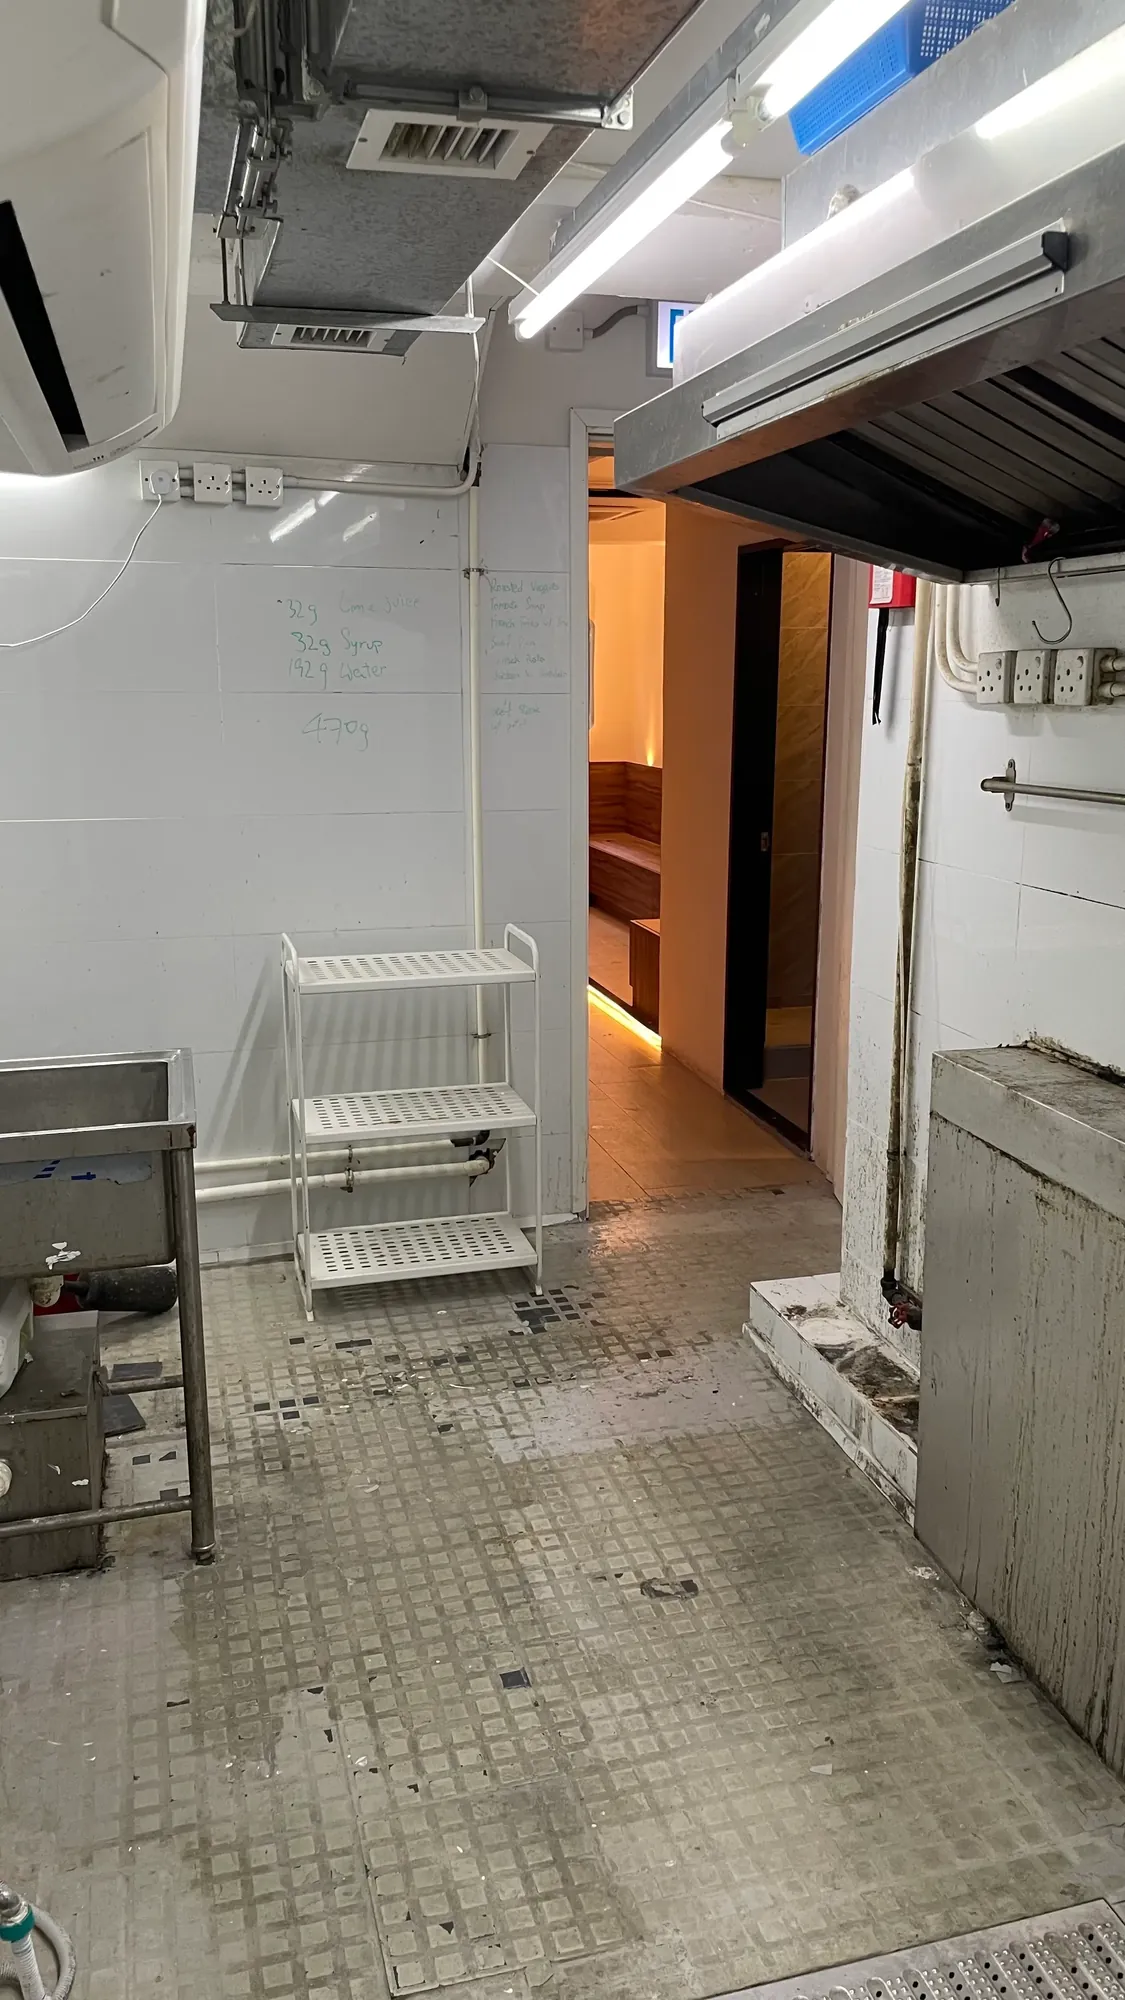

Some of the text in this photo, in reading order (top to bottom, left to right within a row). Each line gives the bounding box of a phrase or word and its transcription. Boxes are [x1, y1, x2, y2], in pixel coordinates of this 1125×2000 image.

[290, 626, 384, 657] 32g Syrup
[340, 662, 387, 682] Water
[302, 713, 370, 752] 470g
